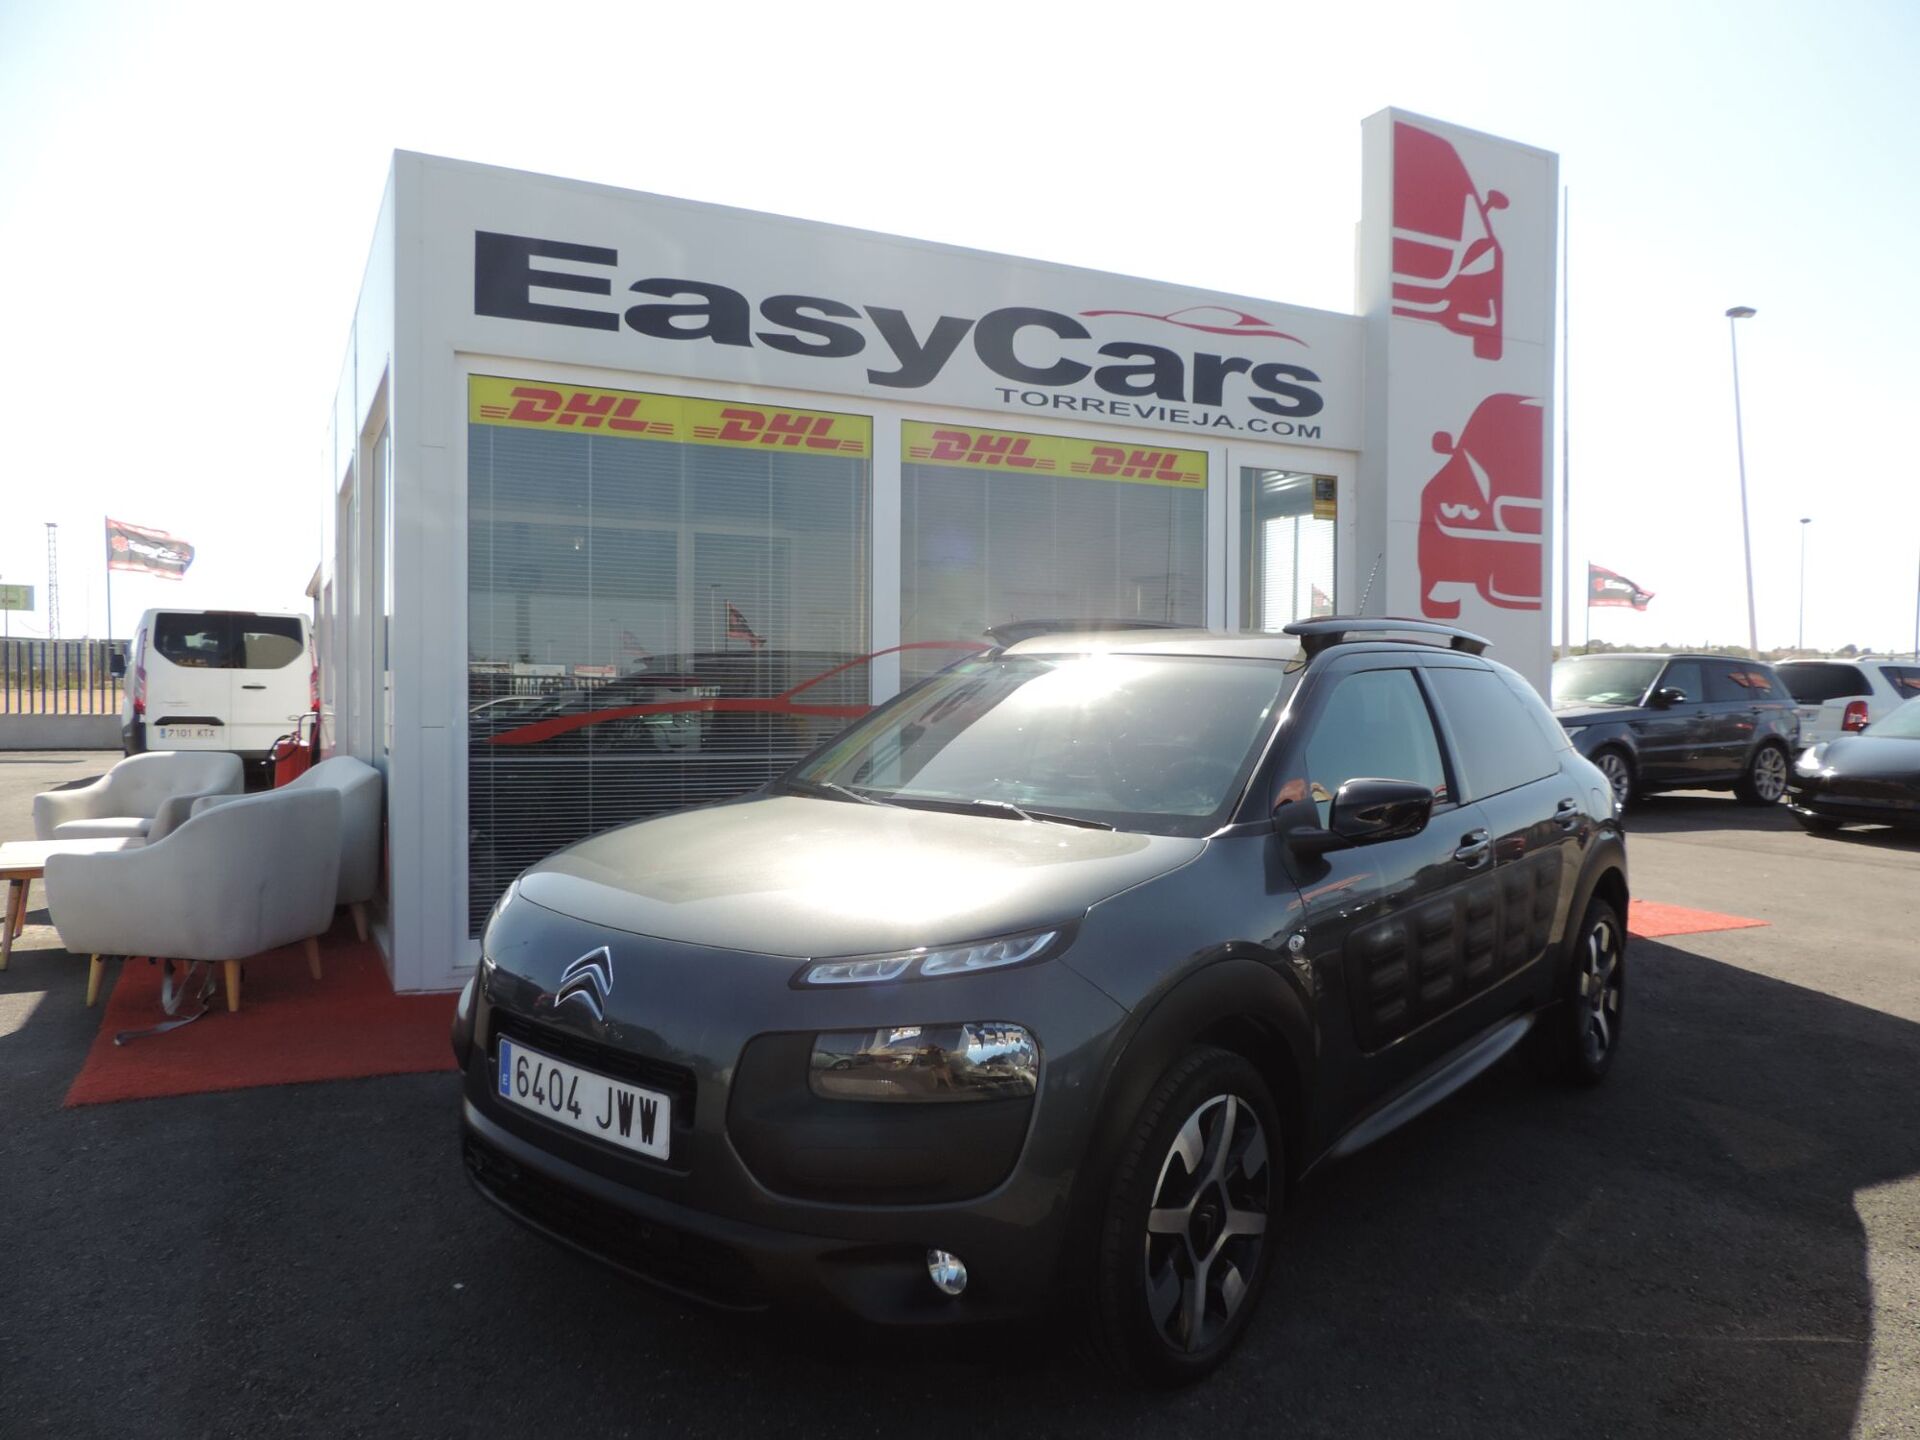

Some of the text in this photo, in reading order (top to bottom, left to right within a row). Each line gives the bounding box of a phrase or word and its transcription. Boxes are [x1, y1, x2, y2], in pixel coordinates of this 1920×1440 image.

[474, 230, 1325, 418] EasyCars
[509, 386, 649, 432] DHL
[718, 408, 842, 450] DHL
[995, 387, 1322, 439] TORREVIEJA.COM
[930, 430, 1041, 468] DHL
[1089, 447, 1185, 482] DHL
[515, 1055, 658, 1146] 6404 JWW
